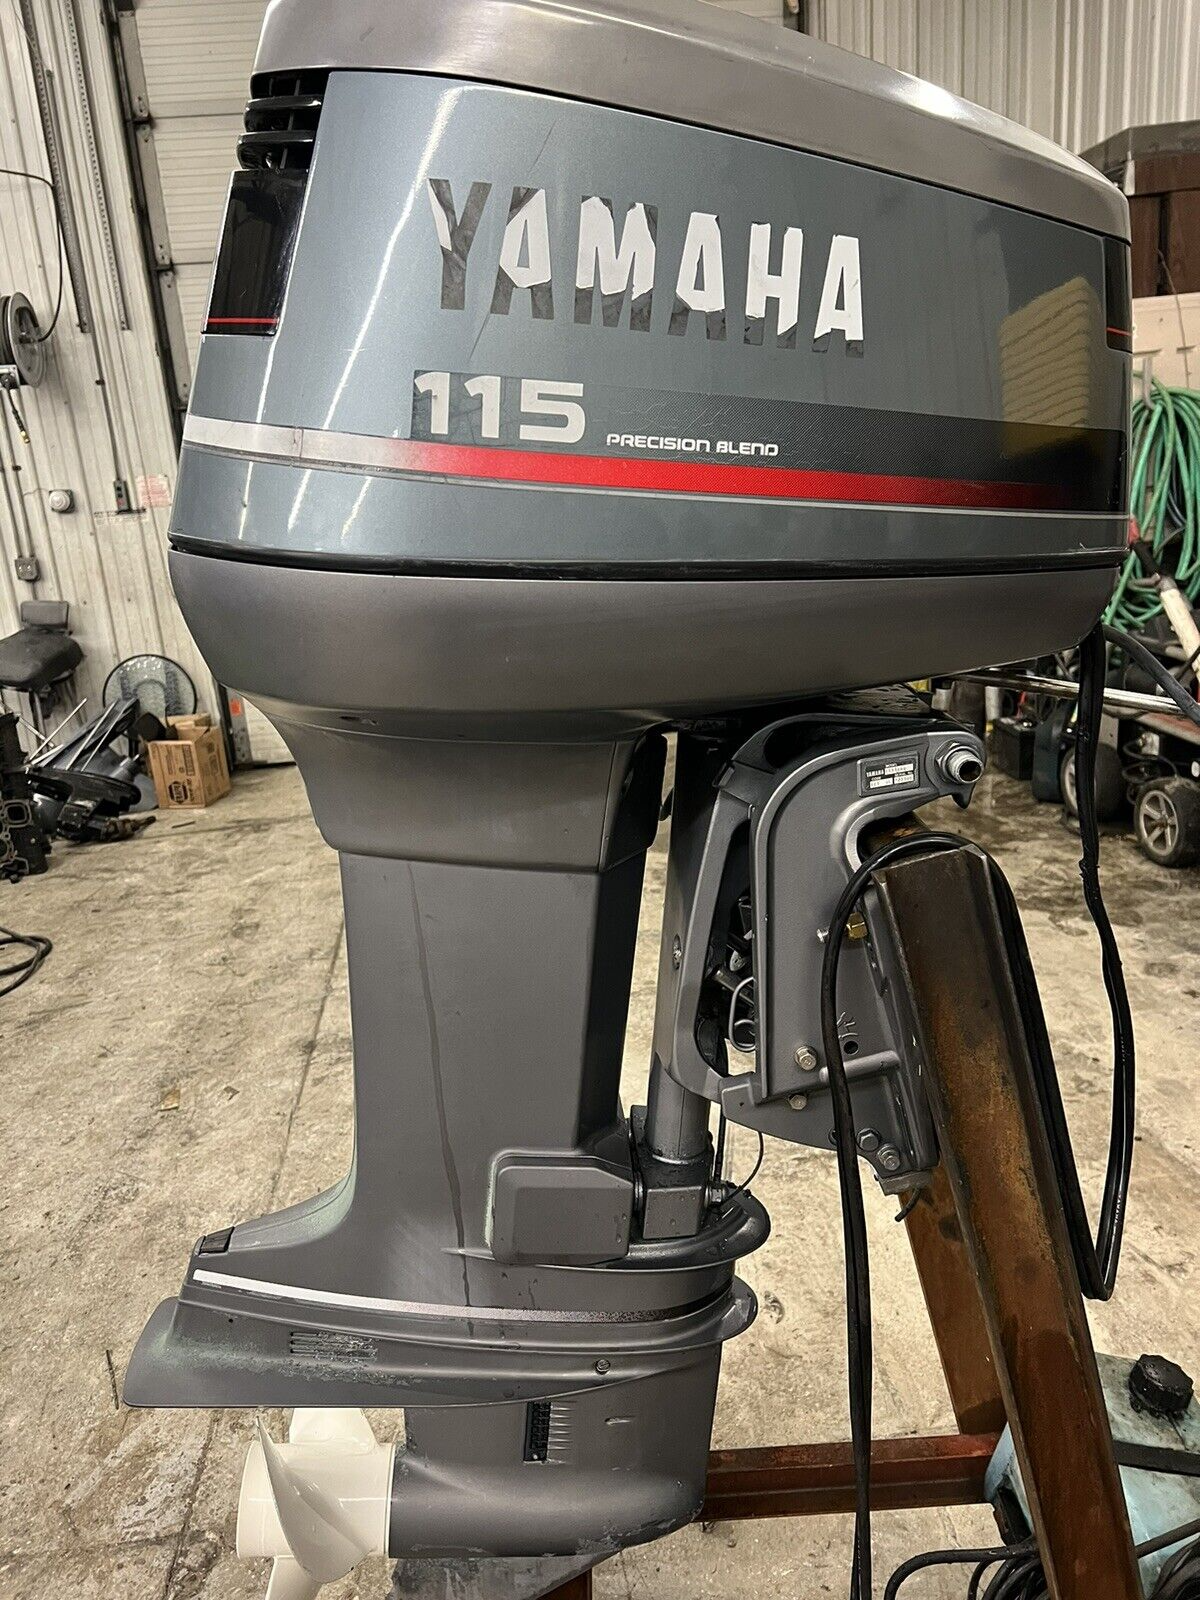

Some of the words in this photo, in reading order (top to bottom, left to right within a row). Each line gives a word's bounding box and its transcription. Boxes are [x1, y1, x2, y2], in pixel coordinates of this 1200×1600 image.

[427, 178, 864, 358] YAMAHA
[413, 371, 586, 444] 115
[606, 433, 711, 453] PRECISION
[716, 440, 779, 457] BLEND
